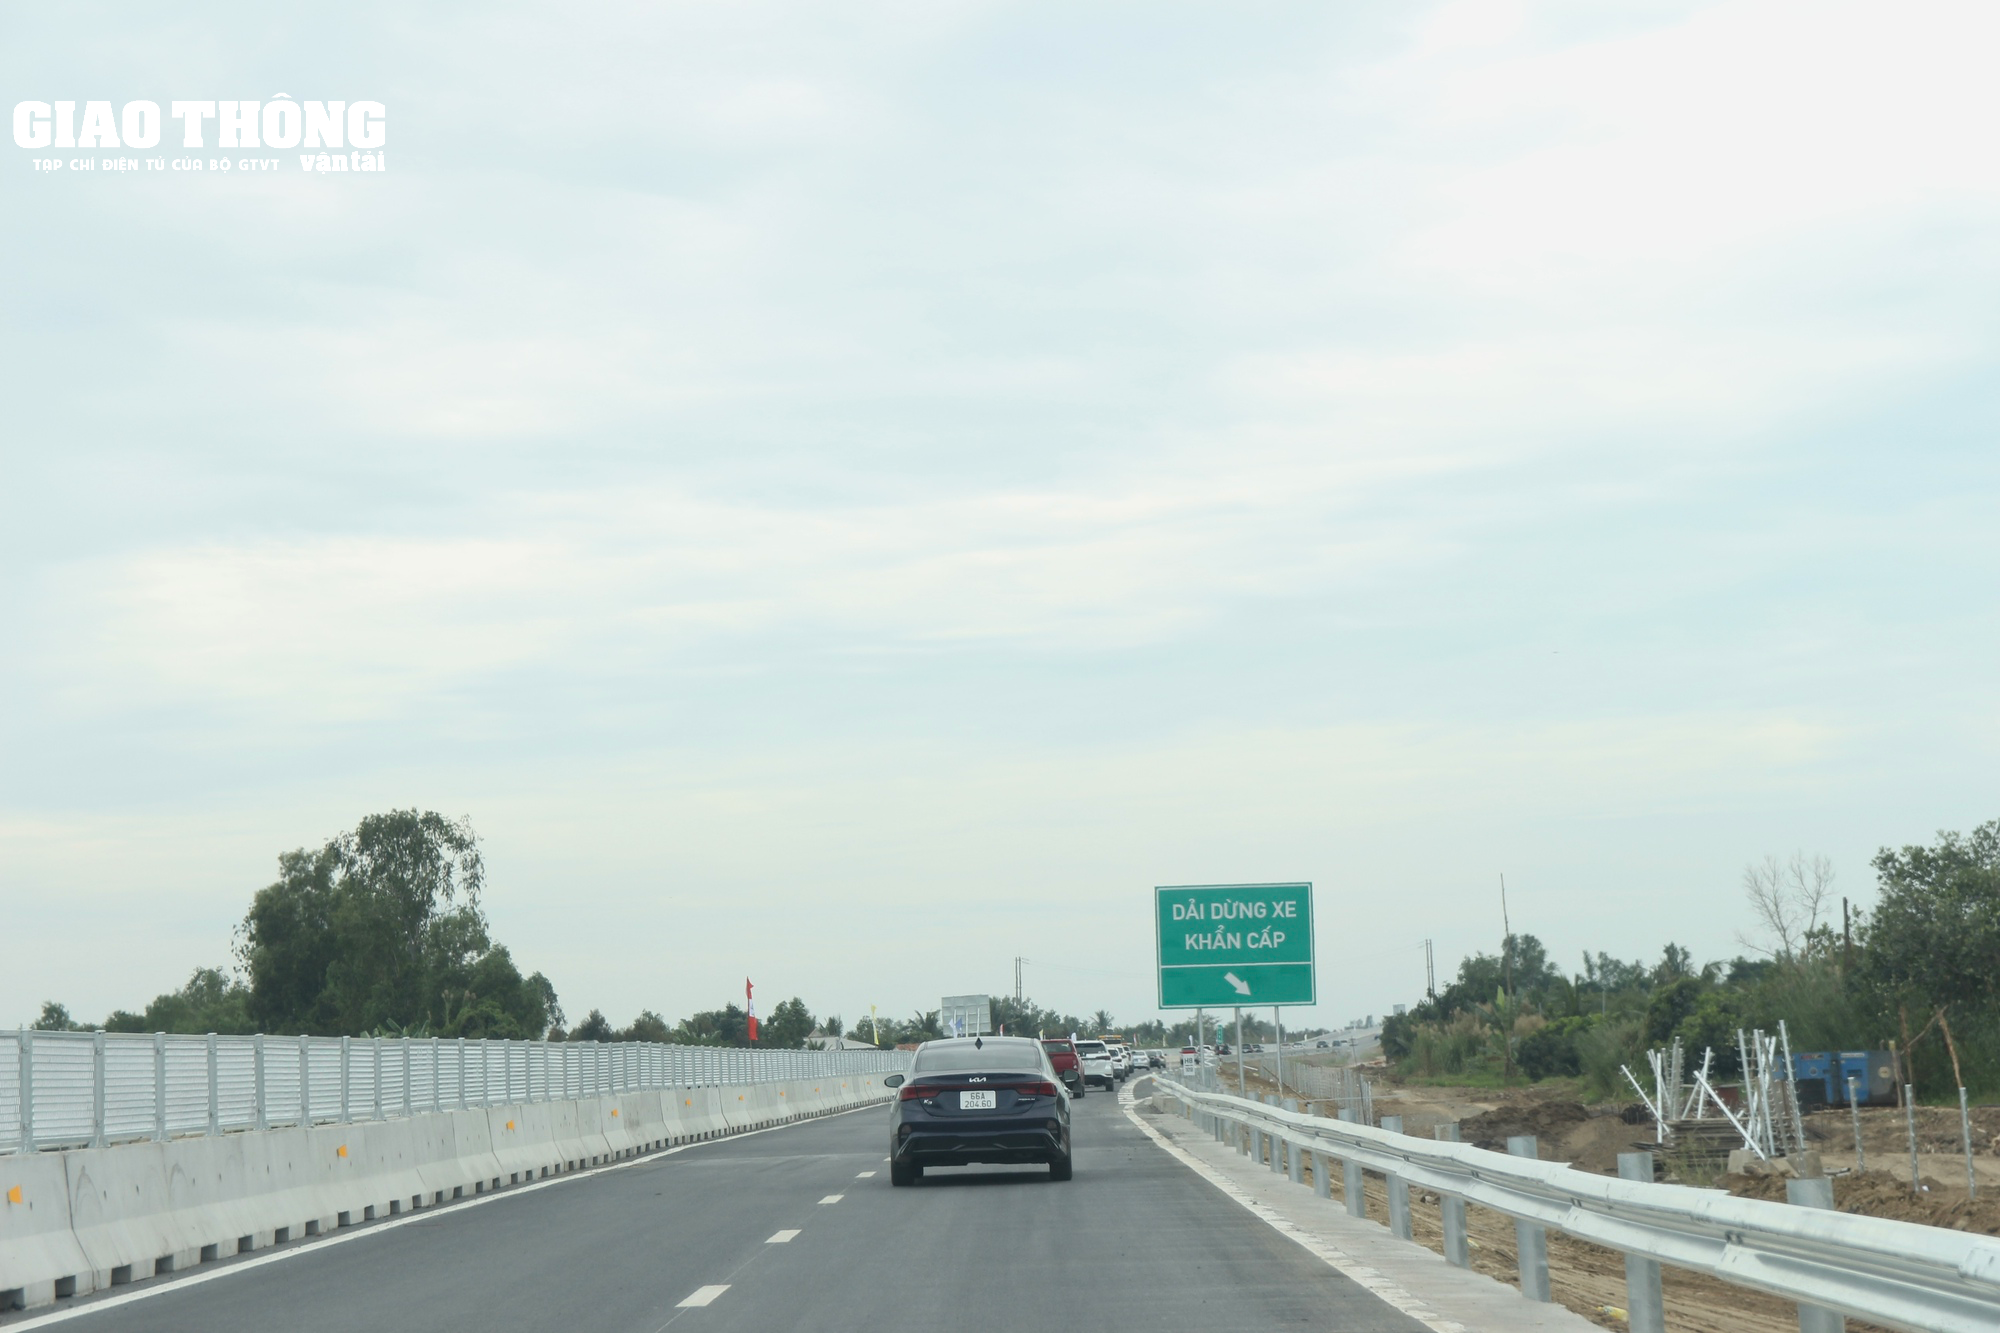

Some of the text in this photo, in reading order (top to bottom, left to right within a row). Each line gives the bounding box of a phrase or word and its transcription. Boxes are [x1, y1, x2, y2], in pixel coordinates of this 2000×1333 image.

[1172, 898, 1297, 921] DẢI DỪNG XE
[1185, 924, 1286, 950] KHẨN CẤP
[970, 1092, 986, 1100] 66A
[964, 1100, 992, 1108] 204.60
